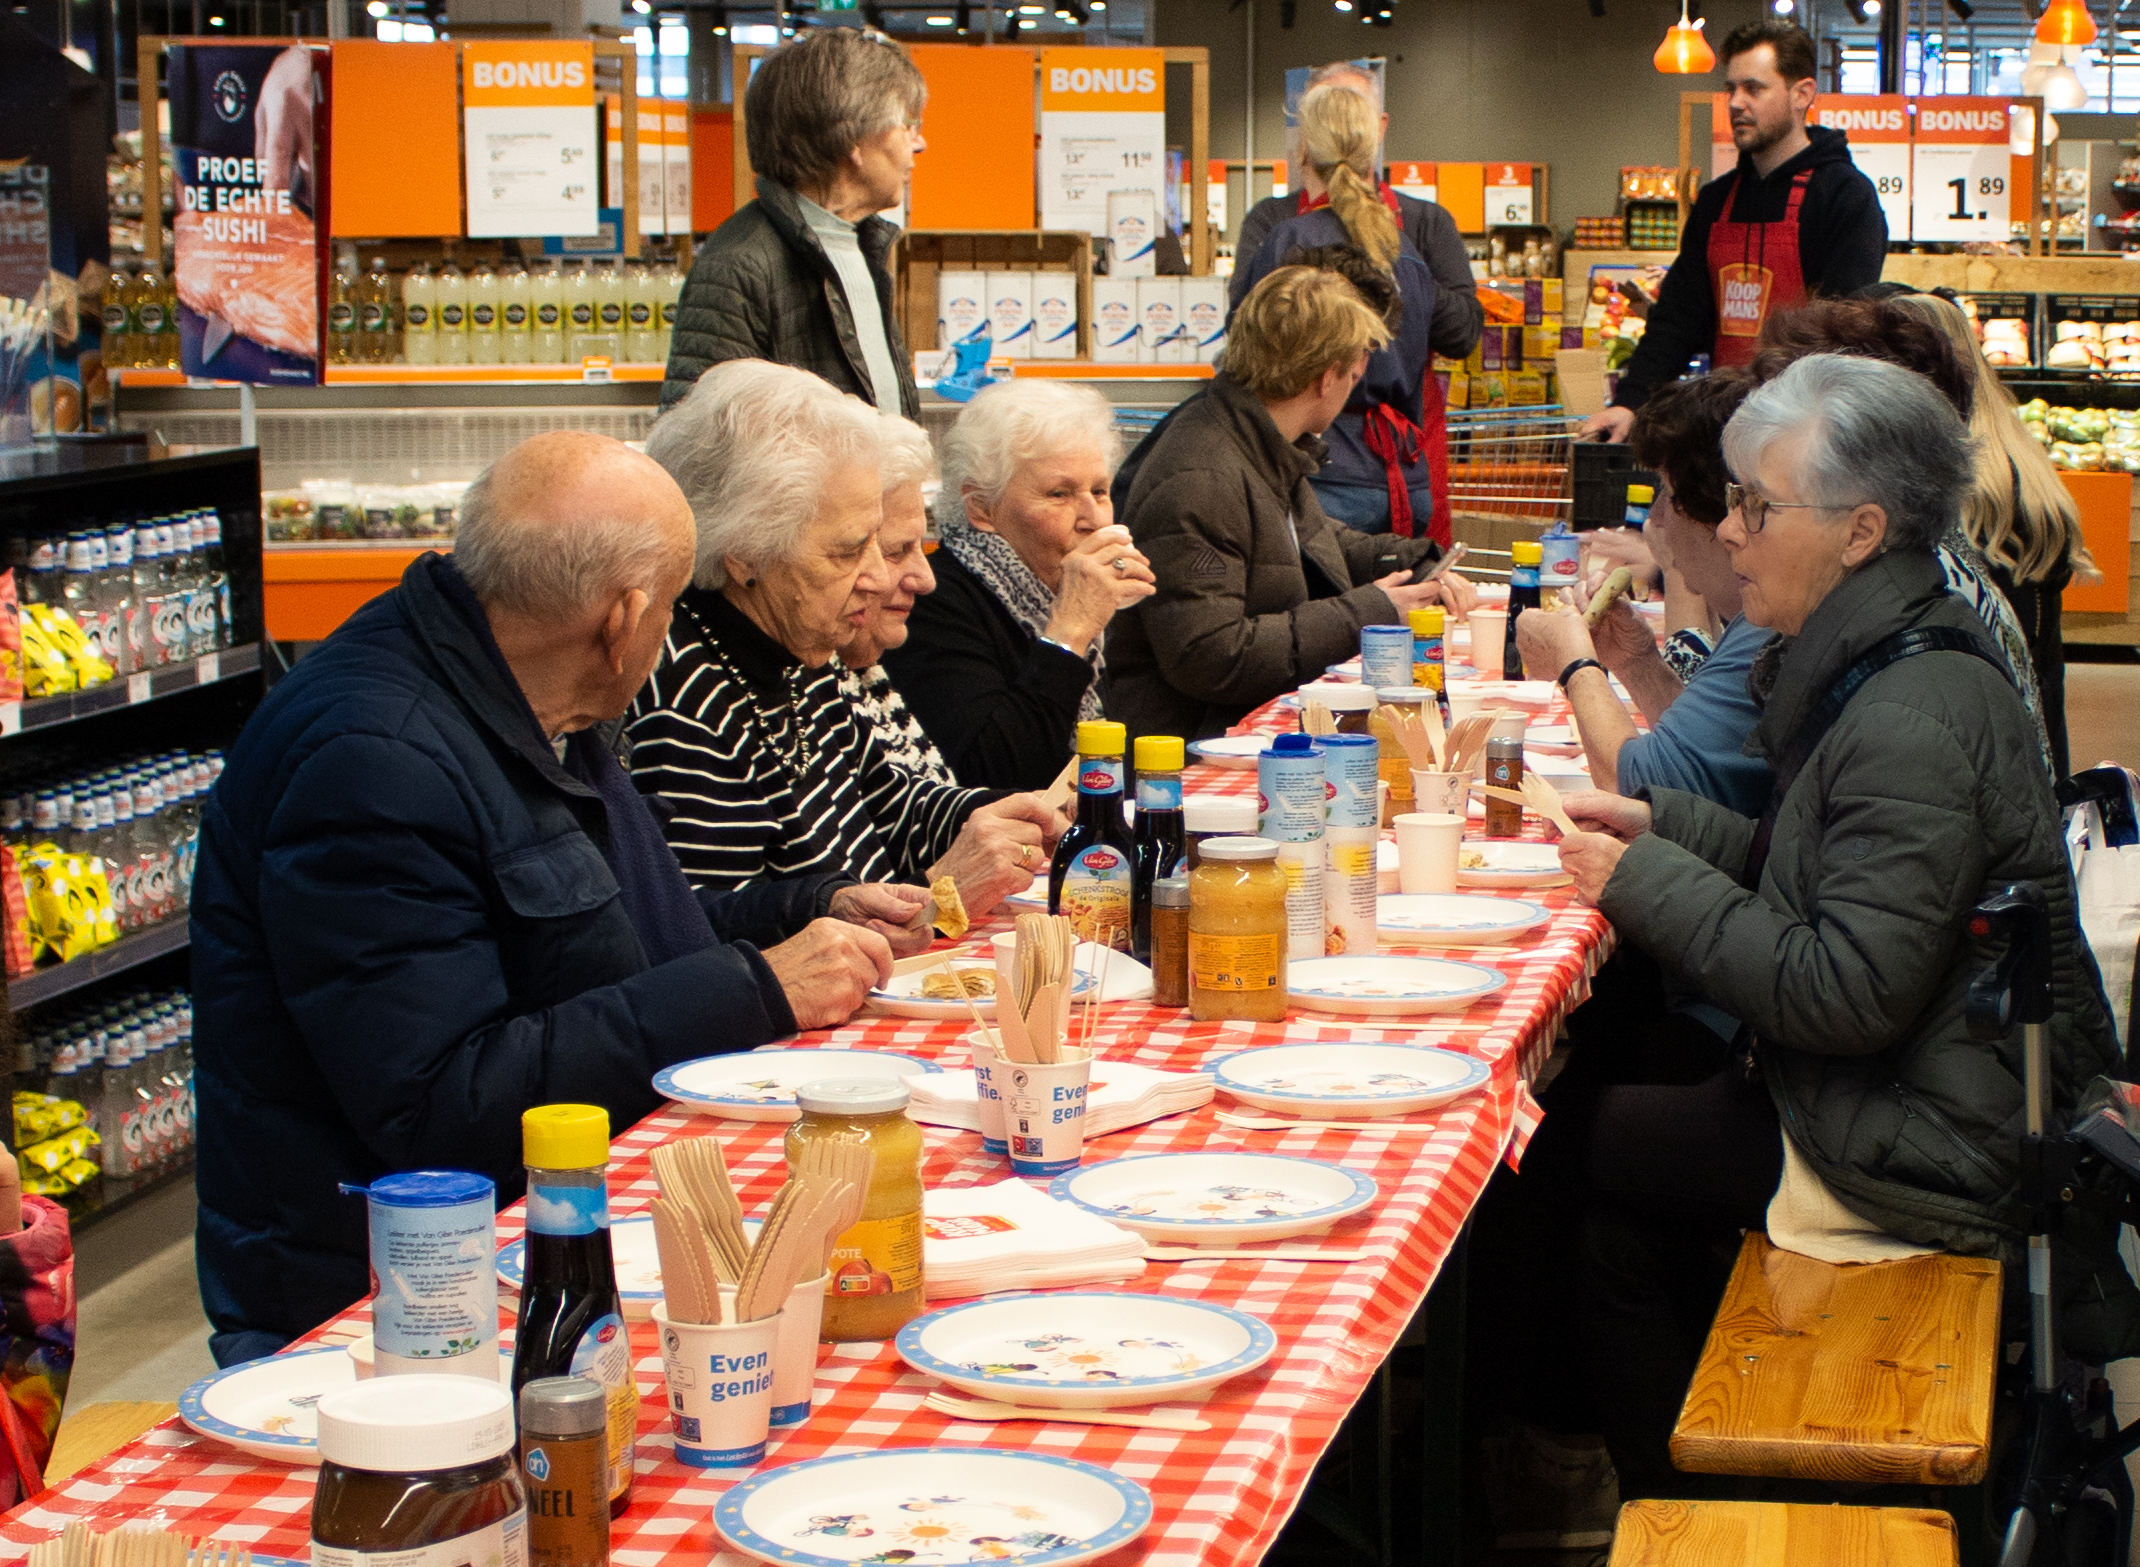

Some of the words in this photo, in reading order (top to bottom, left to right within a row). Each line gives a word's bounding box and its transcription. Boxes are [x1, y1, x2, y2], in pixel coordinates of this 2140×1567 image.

[473, 61, 586, 88] BONUS
[1050, 67, 1156, 93] BONUS
[1819, 109, 1904, 131] BONUS
[1920, 110, 2004, 131] BONUS
[197, 156, 270, 184] PROEF
[184, 185, 210, 211] DE
[216, 187, 292, 215] ECHTE
[202, 217, 267, 244] SUSHI
[1725, 280, 1763, 301] KOOP
[1723, 301, 1760, 320] MANS
[830, 1248, 862, 1259] POTE
[710, 1351, 768, 1373] Even
[711, 1369, 774, 1402] geniet
[529, 1488, 575, 1518] NEEL
